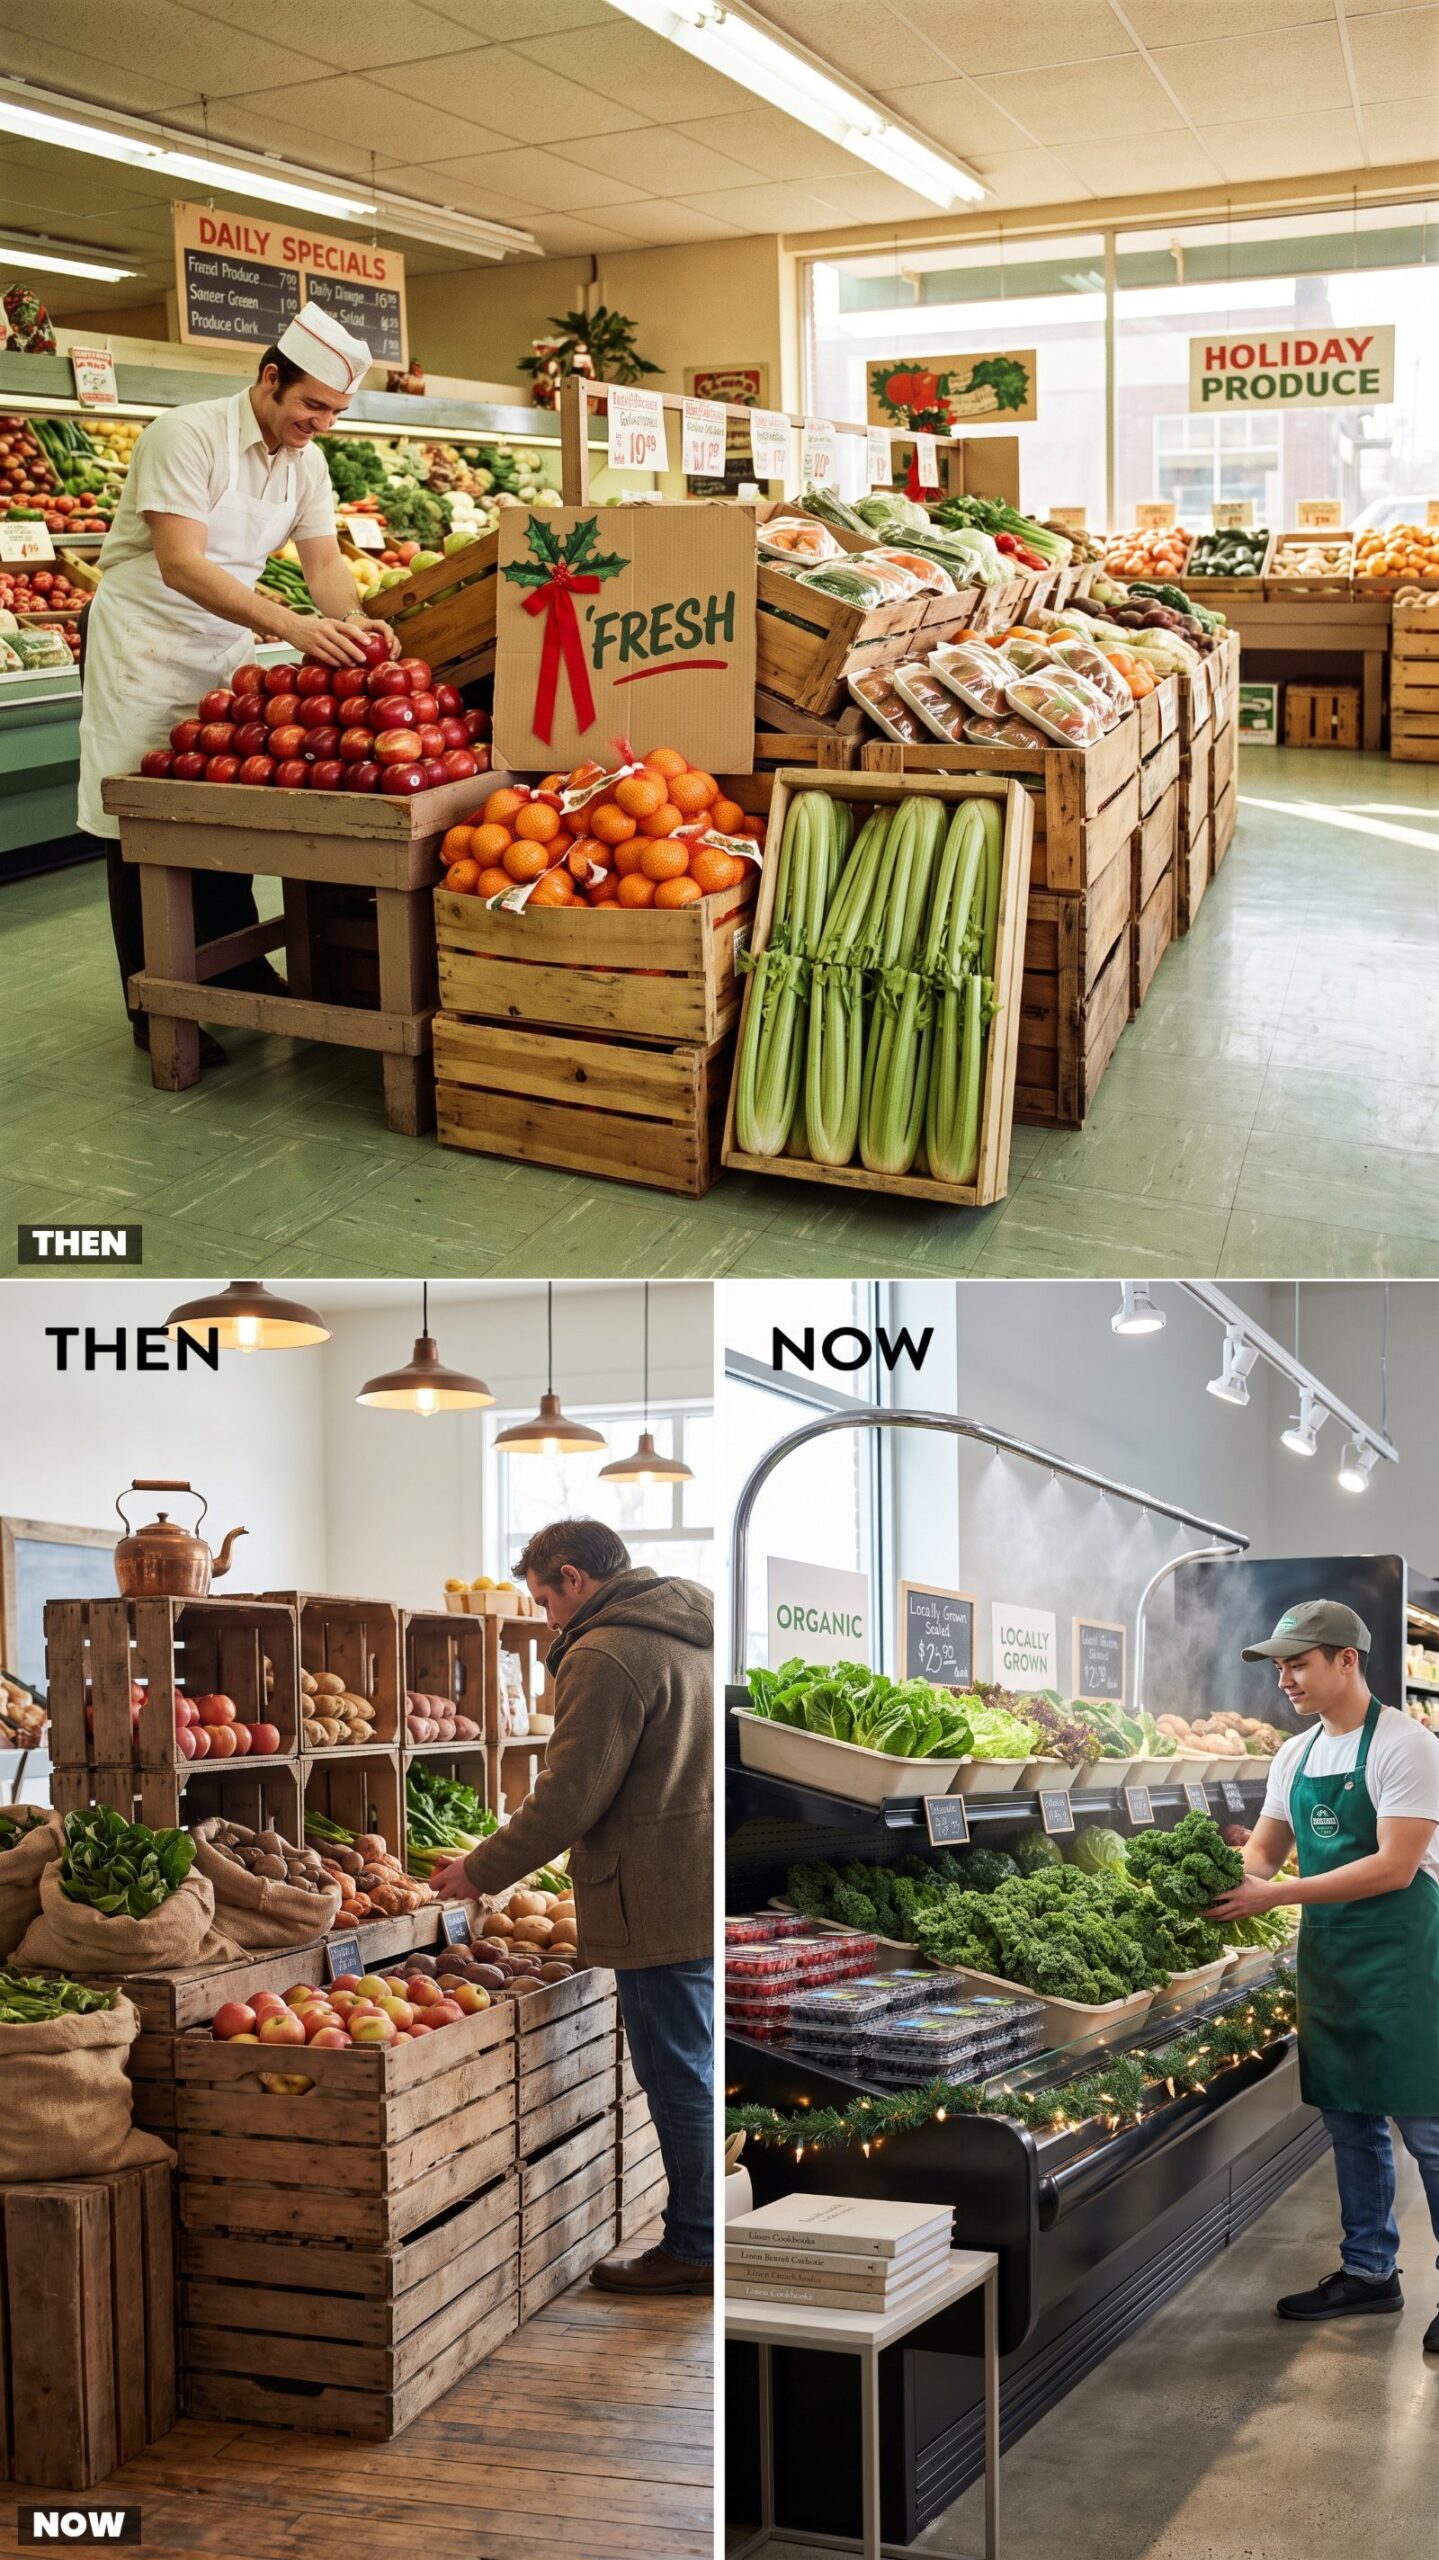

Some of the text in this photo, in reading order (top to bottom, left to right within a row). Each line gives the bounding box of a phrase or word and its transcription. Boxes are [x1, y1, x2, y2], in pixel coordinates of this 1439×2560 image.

[199, 217, 386, 281] DAILY SPECIALS
[222, 262, 260, 285] Produce
[191, 310, 232, 332] Produce
[1205, 336, 1374, 371] HOLIDAY
[1202, 368, 1380, 402] PRODUCE
[776, 1604, 863, 1639] ORGANIC
[910, 1596, 940, 1624] Locally
[1000, 1626, 1049, 1651] LOCALLY
[1003, 1651, 1048, 1673] GROWN
